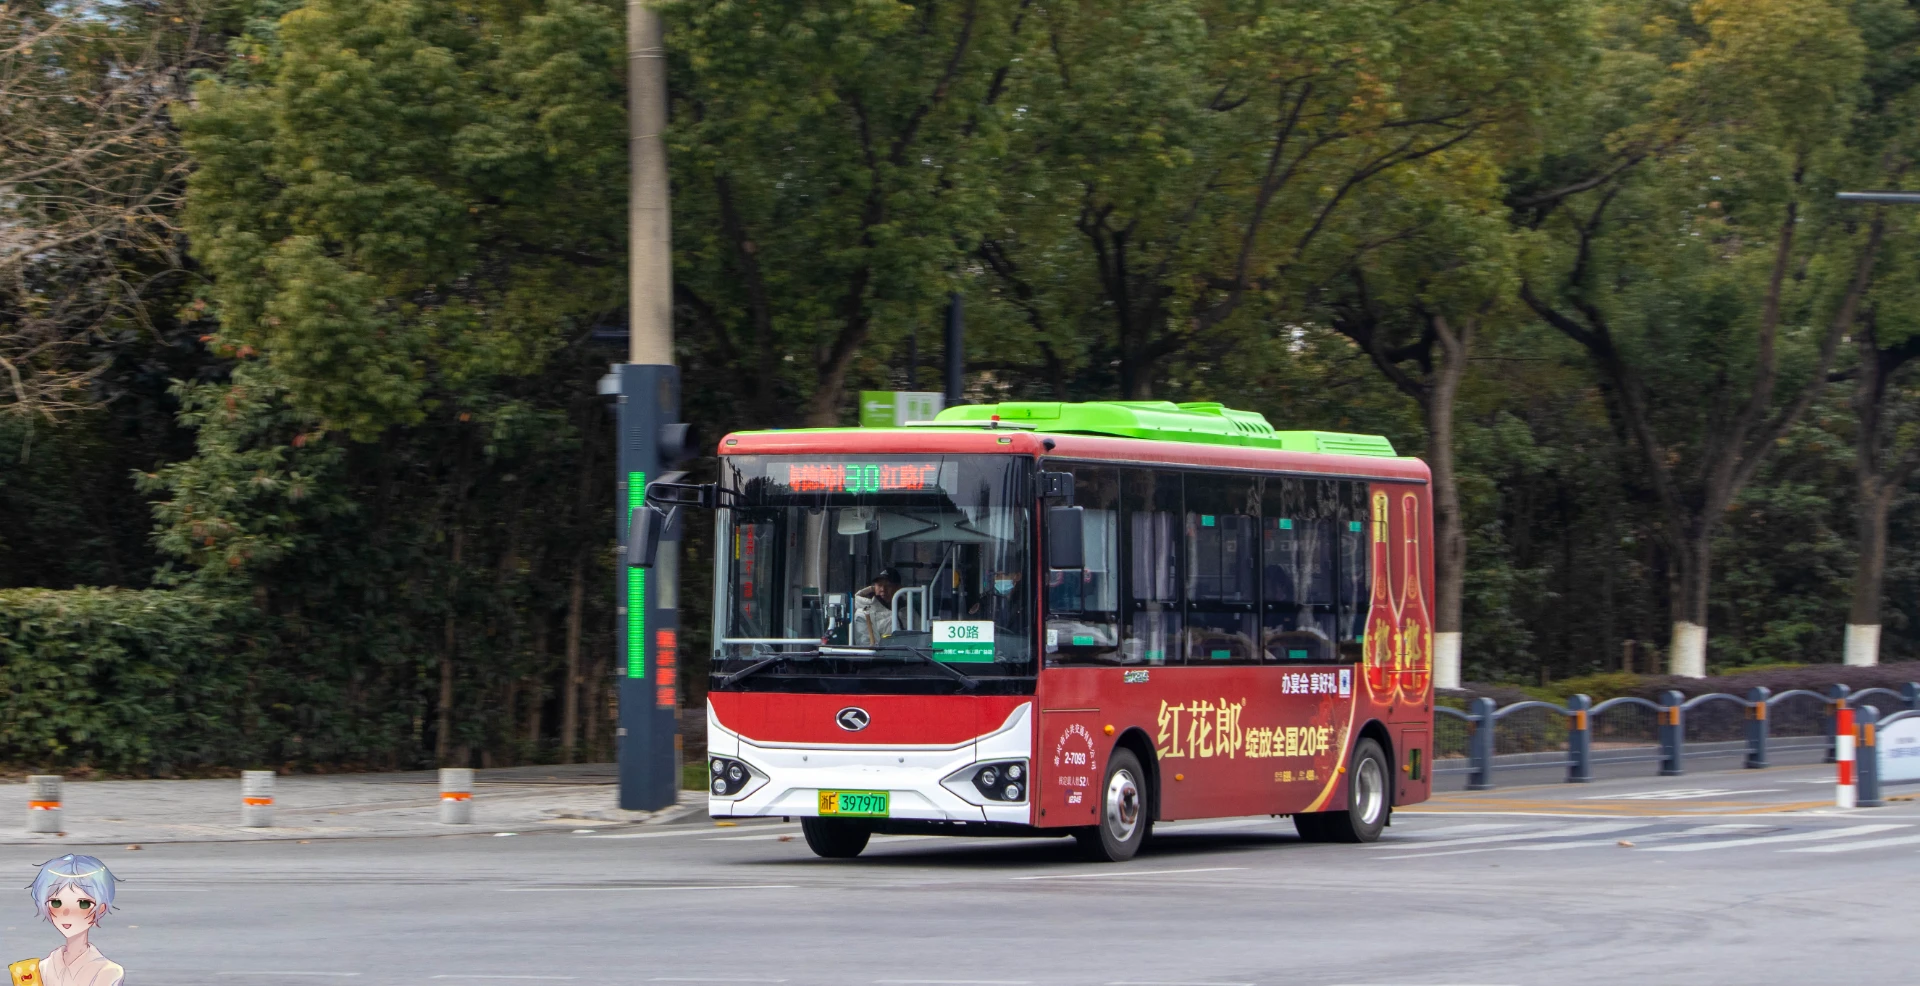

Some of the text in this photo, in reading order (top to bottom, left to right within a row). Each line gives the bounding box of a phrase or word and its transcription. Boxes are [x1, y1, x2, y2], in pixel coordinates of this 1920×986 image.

[845, 465, 879, 492] 30
[947, 625, 979, 639] 30路
[1281, 673, 1338, 694] 办宴会 享好礼
[1157, 697, 1243, 761] 红花郎
[1245, 725, 1330, 759] 绽放全国20年
[1064, 751, 1086, 765] 2-7093
